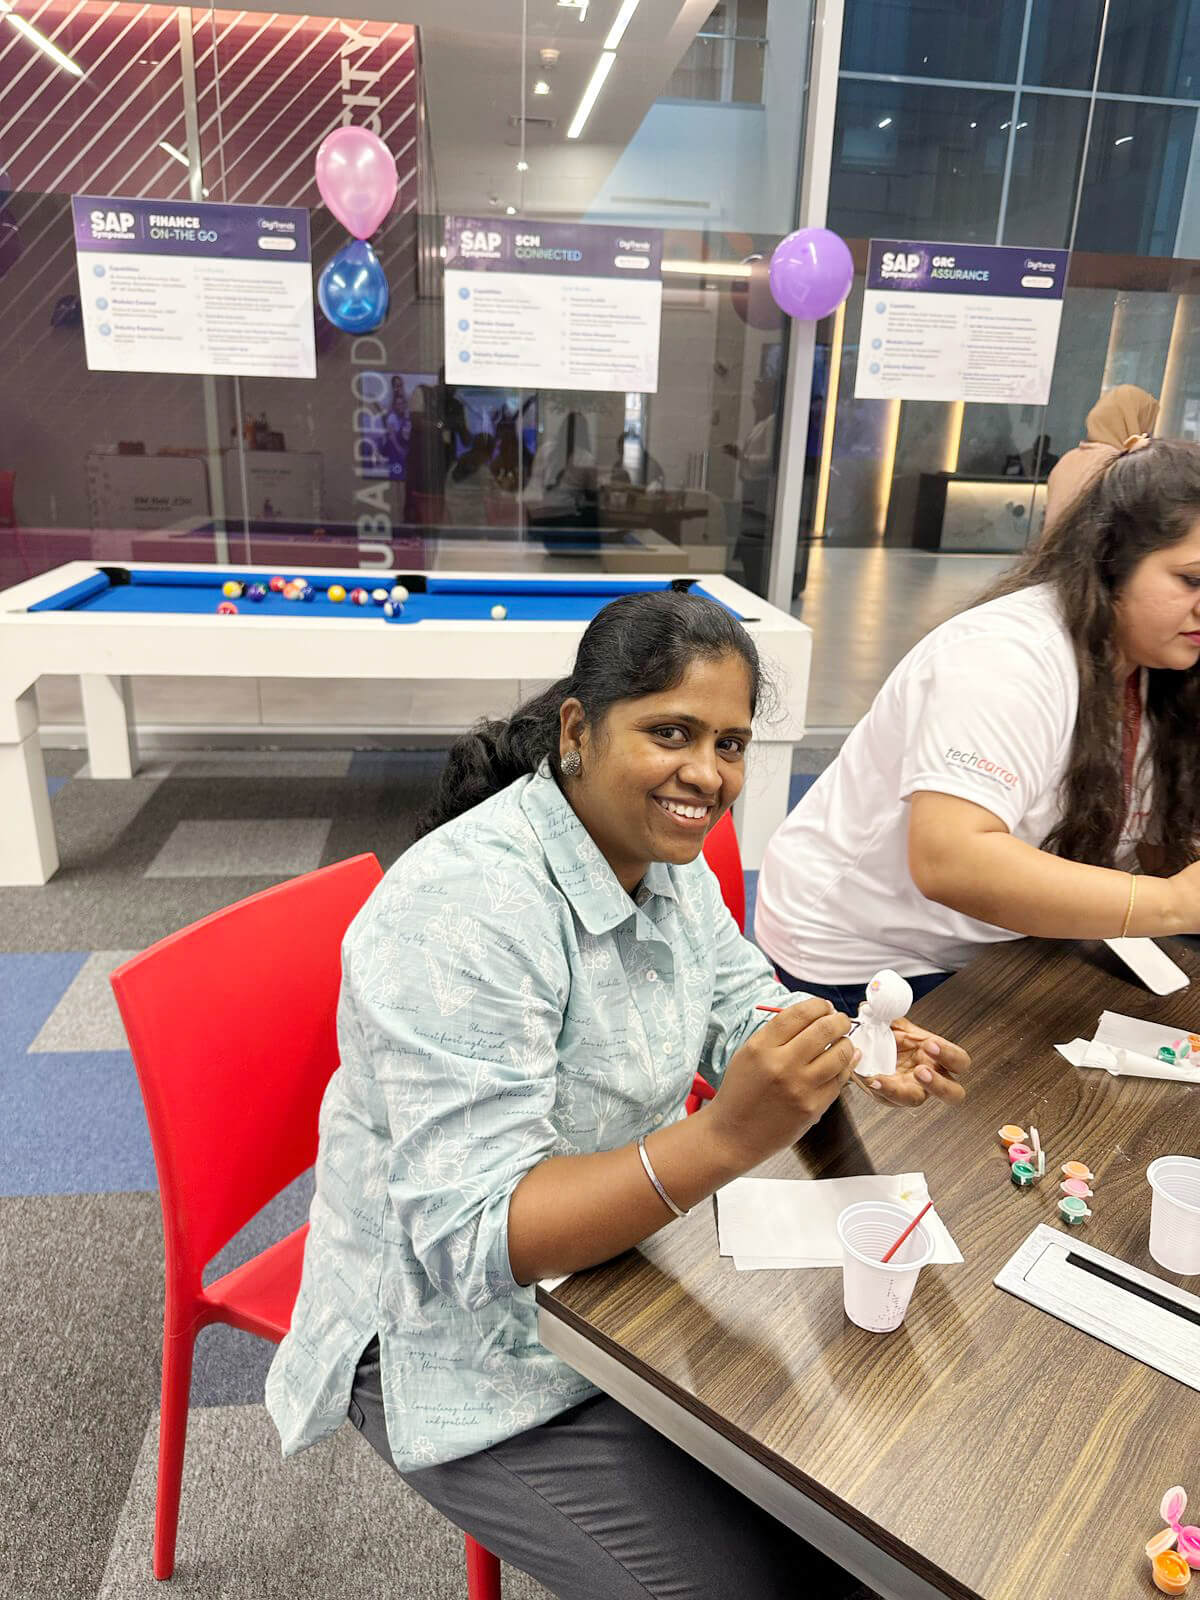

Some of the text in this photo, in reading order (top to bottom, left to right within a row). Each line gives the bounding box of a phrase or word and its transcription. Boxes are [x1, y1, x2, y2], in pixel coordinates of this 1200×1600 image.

[90, 211, 135, 232] SAP
[149, 215, 200, 229] FINANCE
[150, 230, 218, 242] ON-THE GO
[460, 231, 501, 251] SAP
[515, 248, 582, 262] CONNECTED
[881, 252, 920, 272] SAP
[932, 256, 955, 268] GRC
[931, 268, 990, 282] ASSURANCE
[355, 467, 395, 570] UBAI
[944, 746, 1020, 788] techcarrot
